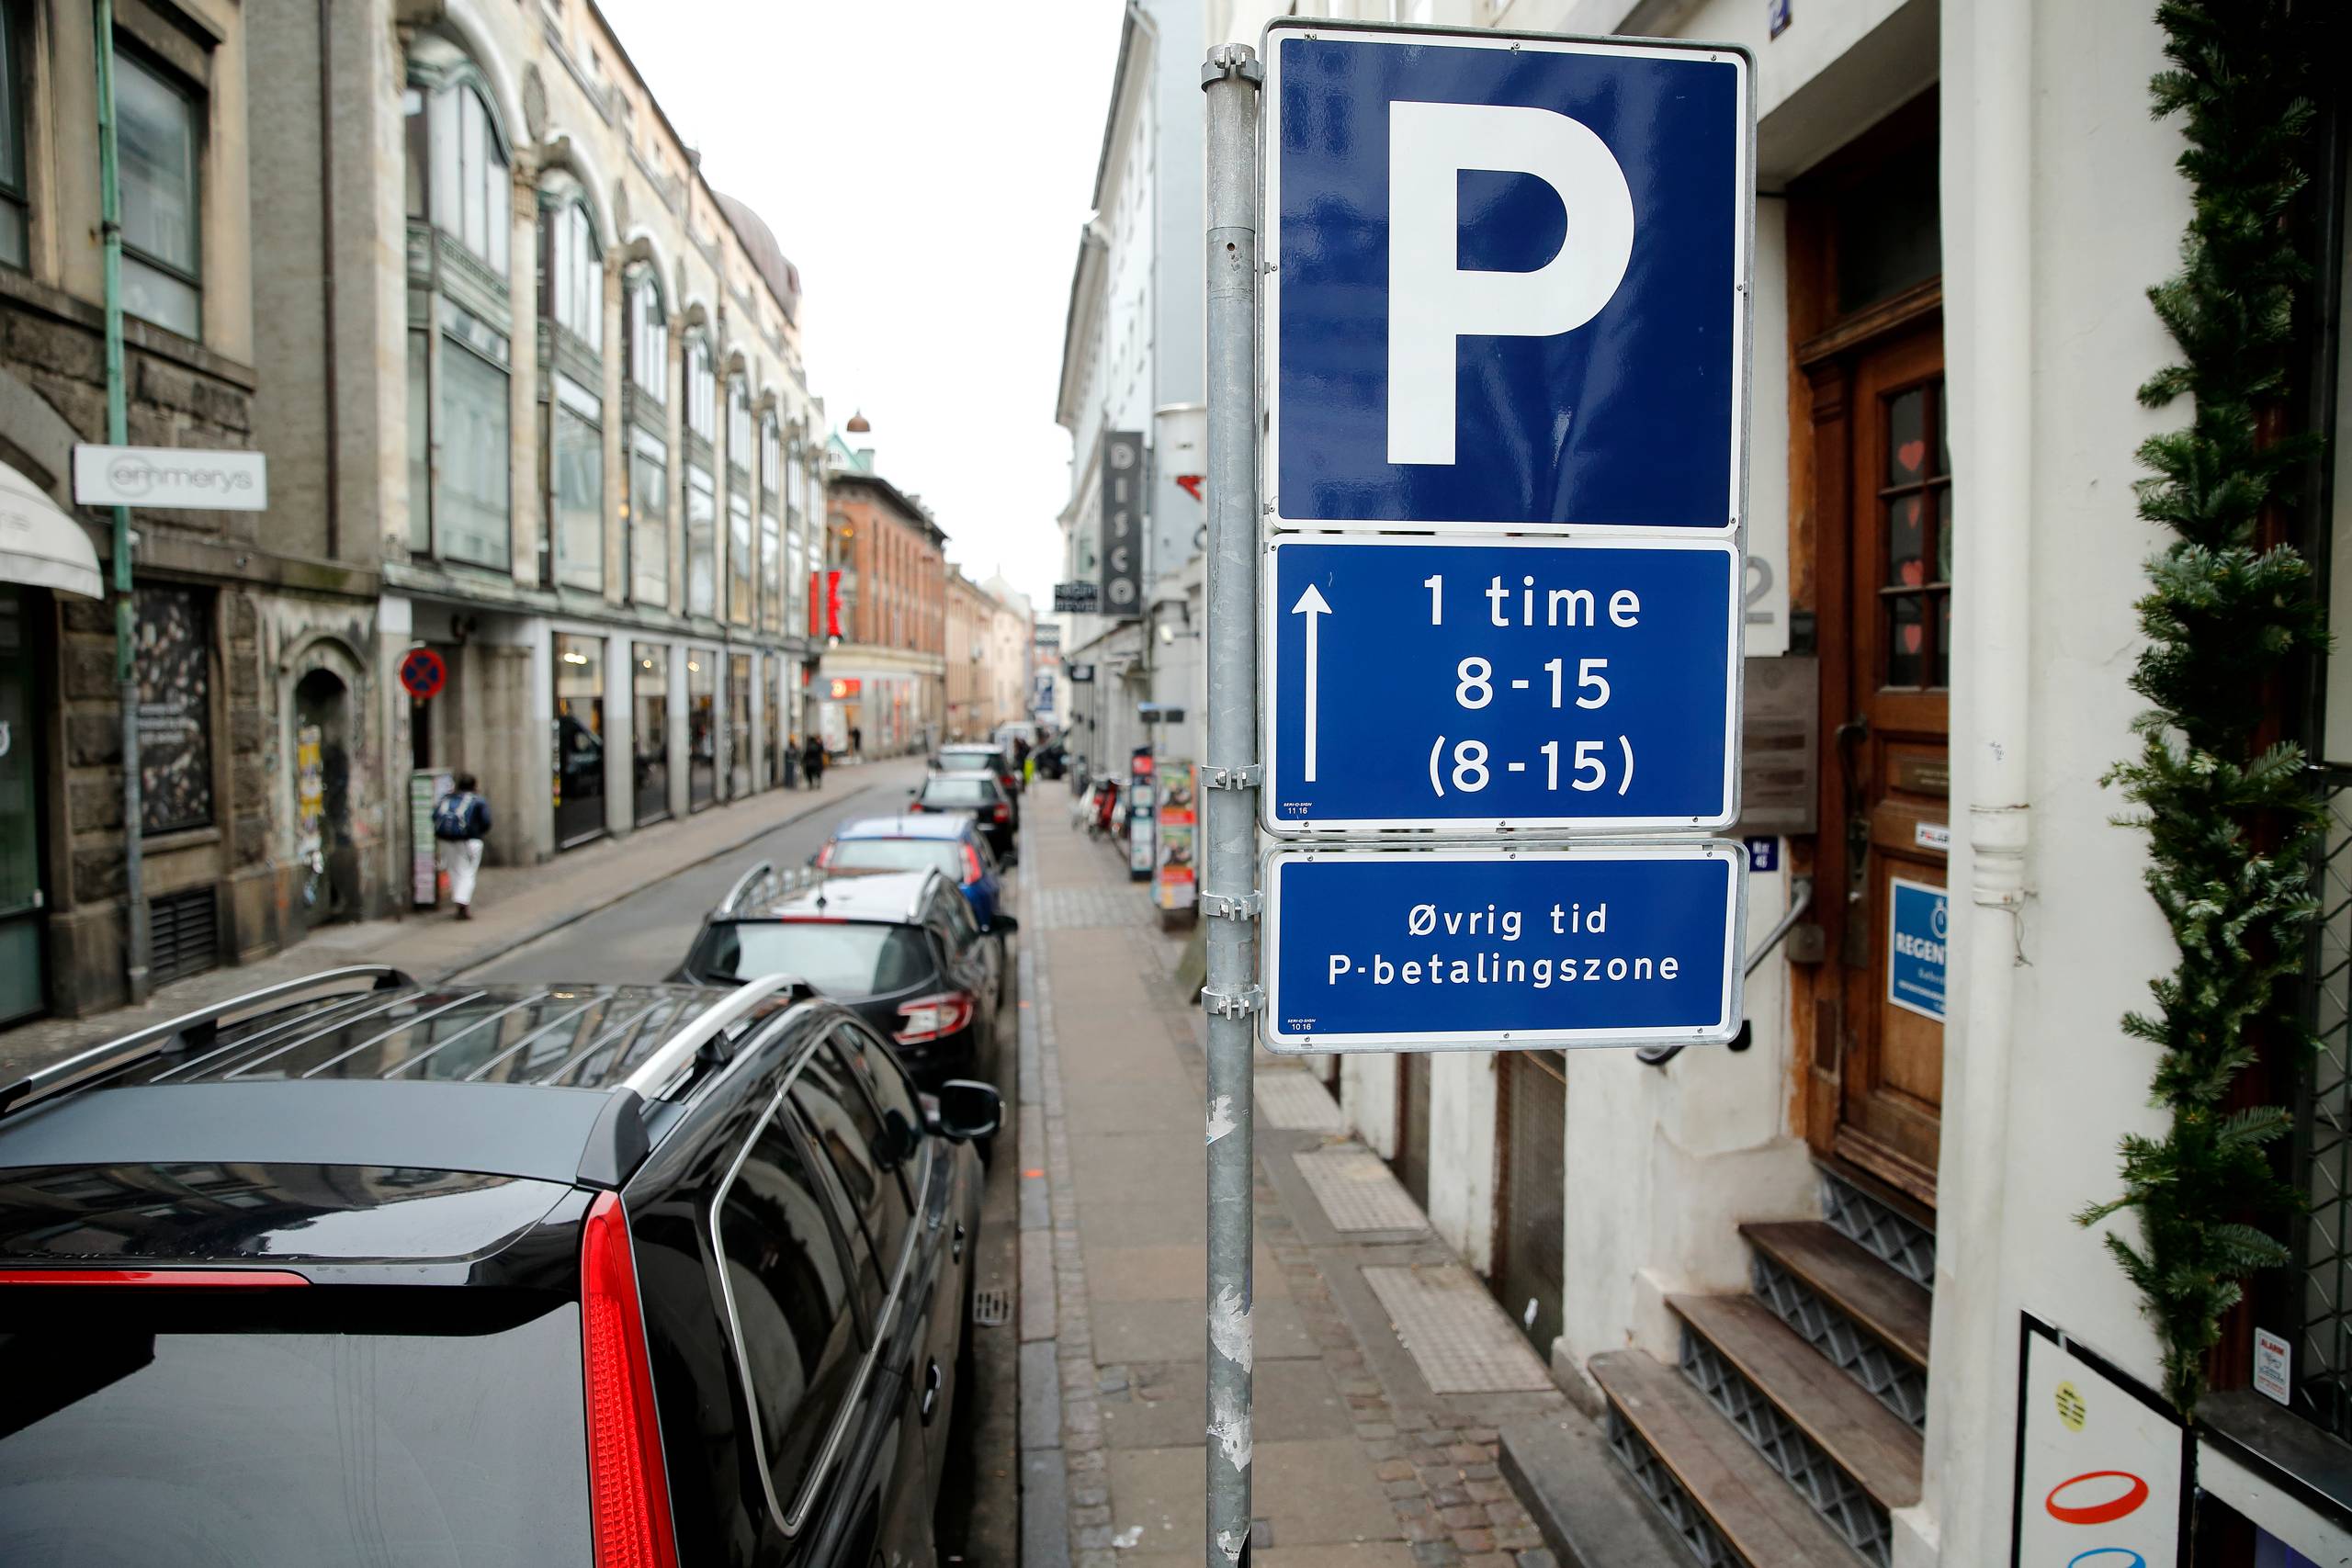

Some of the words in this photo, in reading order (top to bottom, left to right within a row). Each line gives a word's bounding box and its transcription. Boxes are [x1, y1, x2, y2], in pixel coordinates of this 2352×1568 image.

[1386, 100, 1635, 466] P
[112, 463, 254, 494] emmerys
[1109, 442, 1136, 604] DISCO
[1424, 574, 1442, 626] 1
[1486, 576, 1639, 627] time
[1409, 904, 1521, 942] Øvrig
[1551, 903, 1607, 934] tid
[1329, 952, 1679, 988] P-betalingszone
